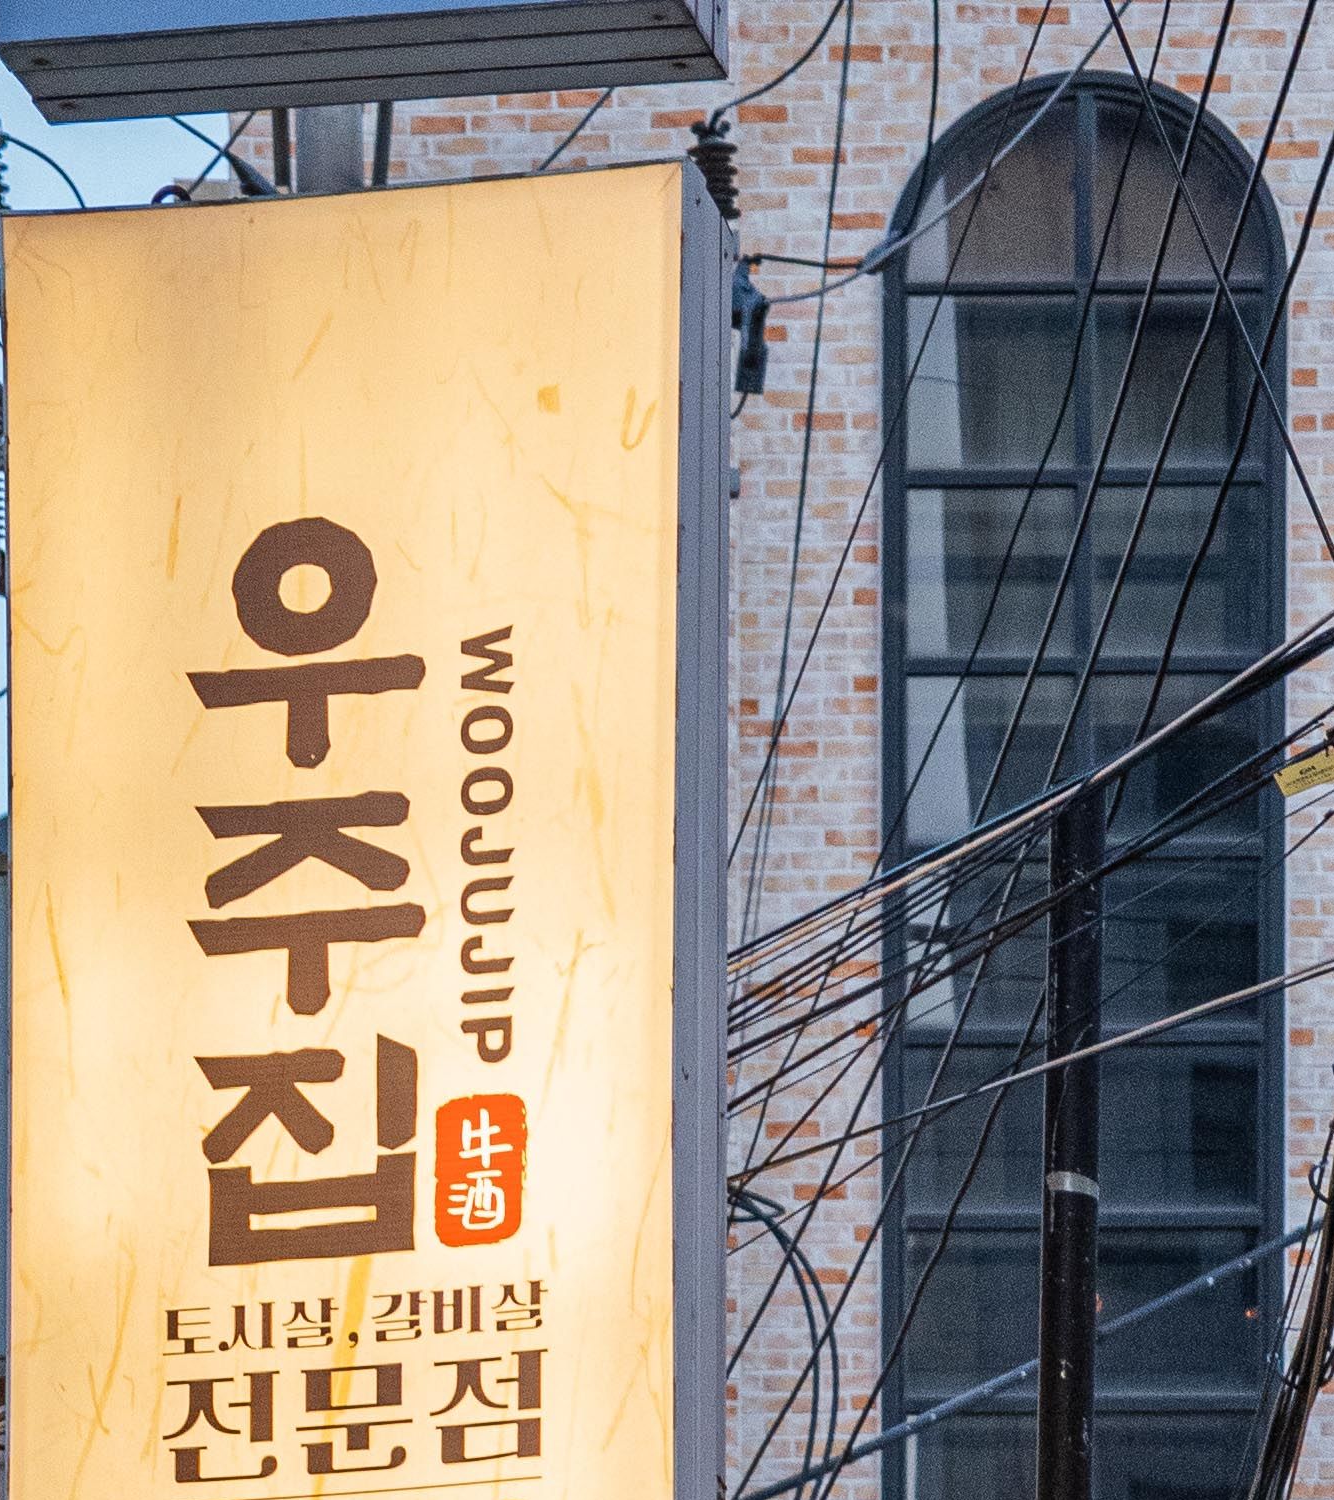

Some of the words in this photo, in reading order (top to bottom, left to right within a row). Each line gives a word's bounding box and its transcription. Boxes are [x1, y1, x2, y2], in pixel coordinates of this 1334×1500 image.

[185, 515, 427, 1267] 우주집
[460, 624, 515, 1063] WOOJUJIP
[162, 1348, 549, 1484] 전문점
